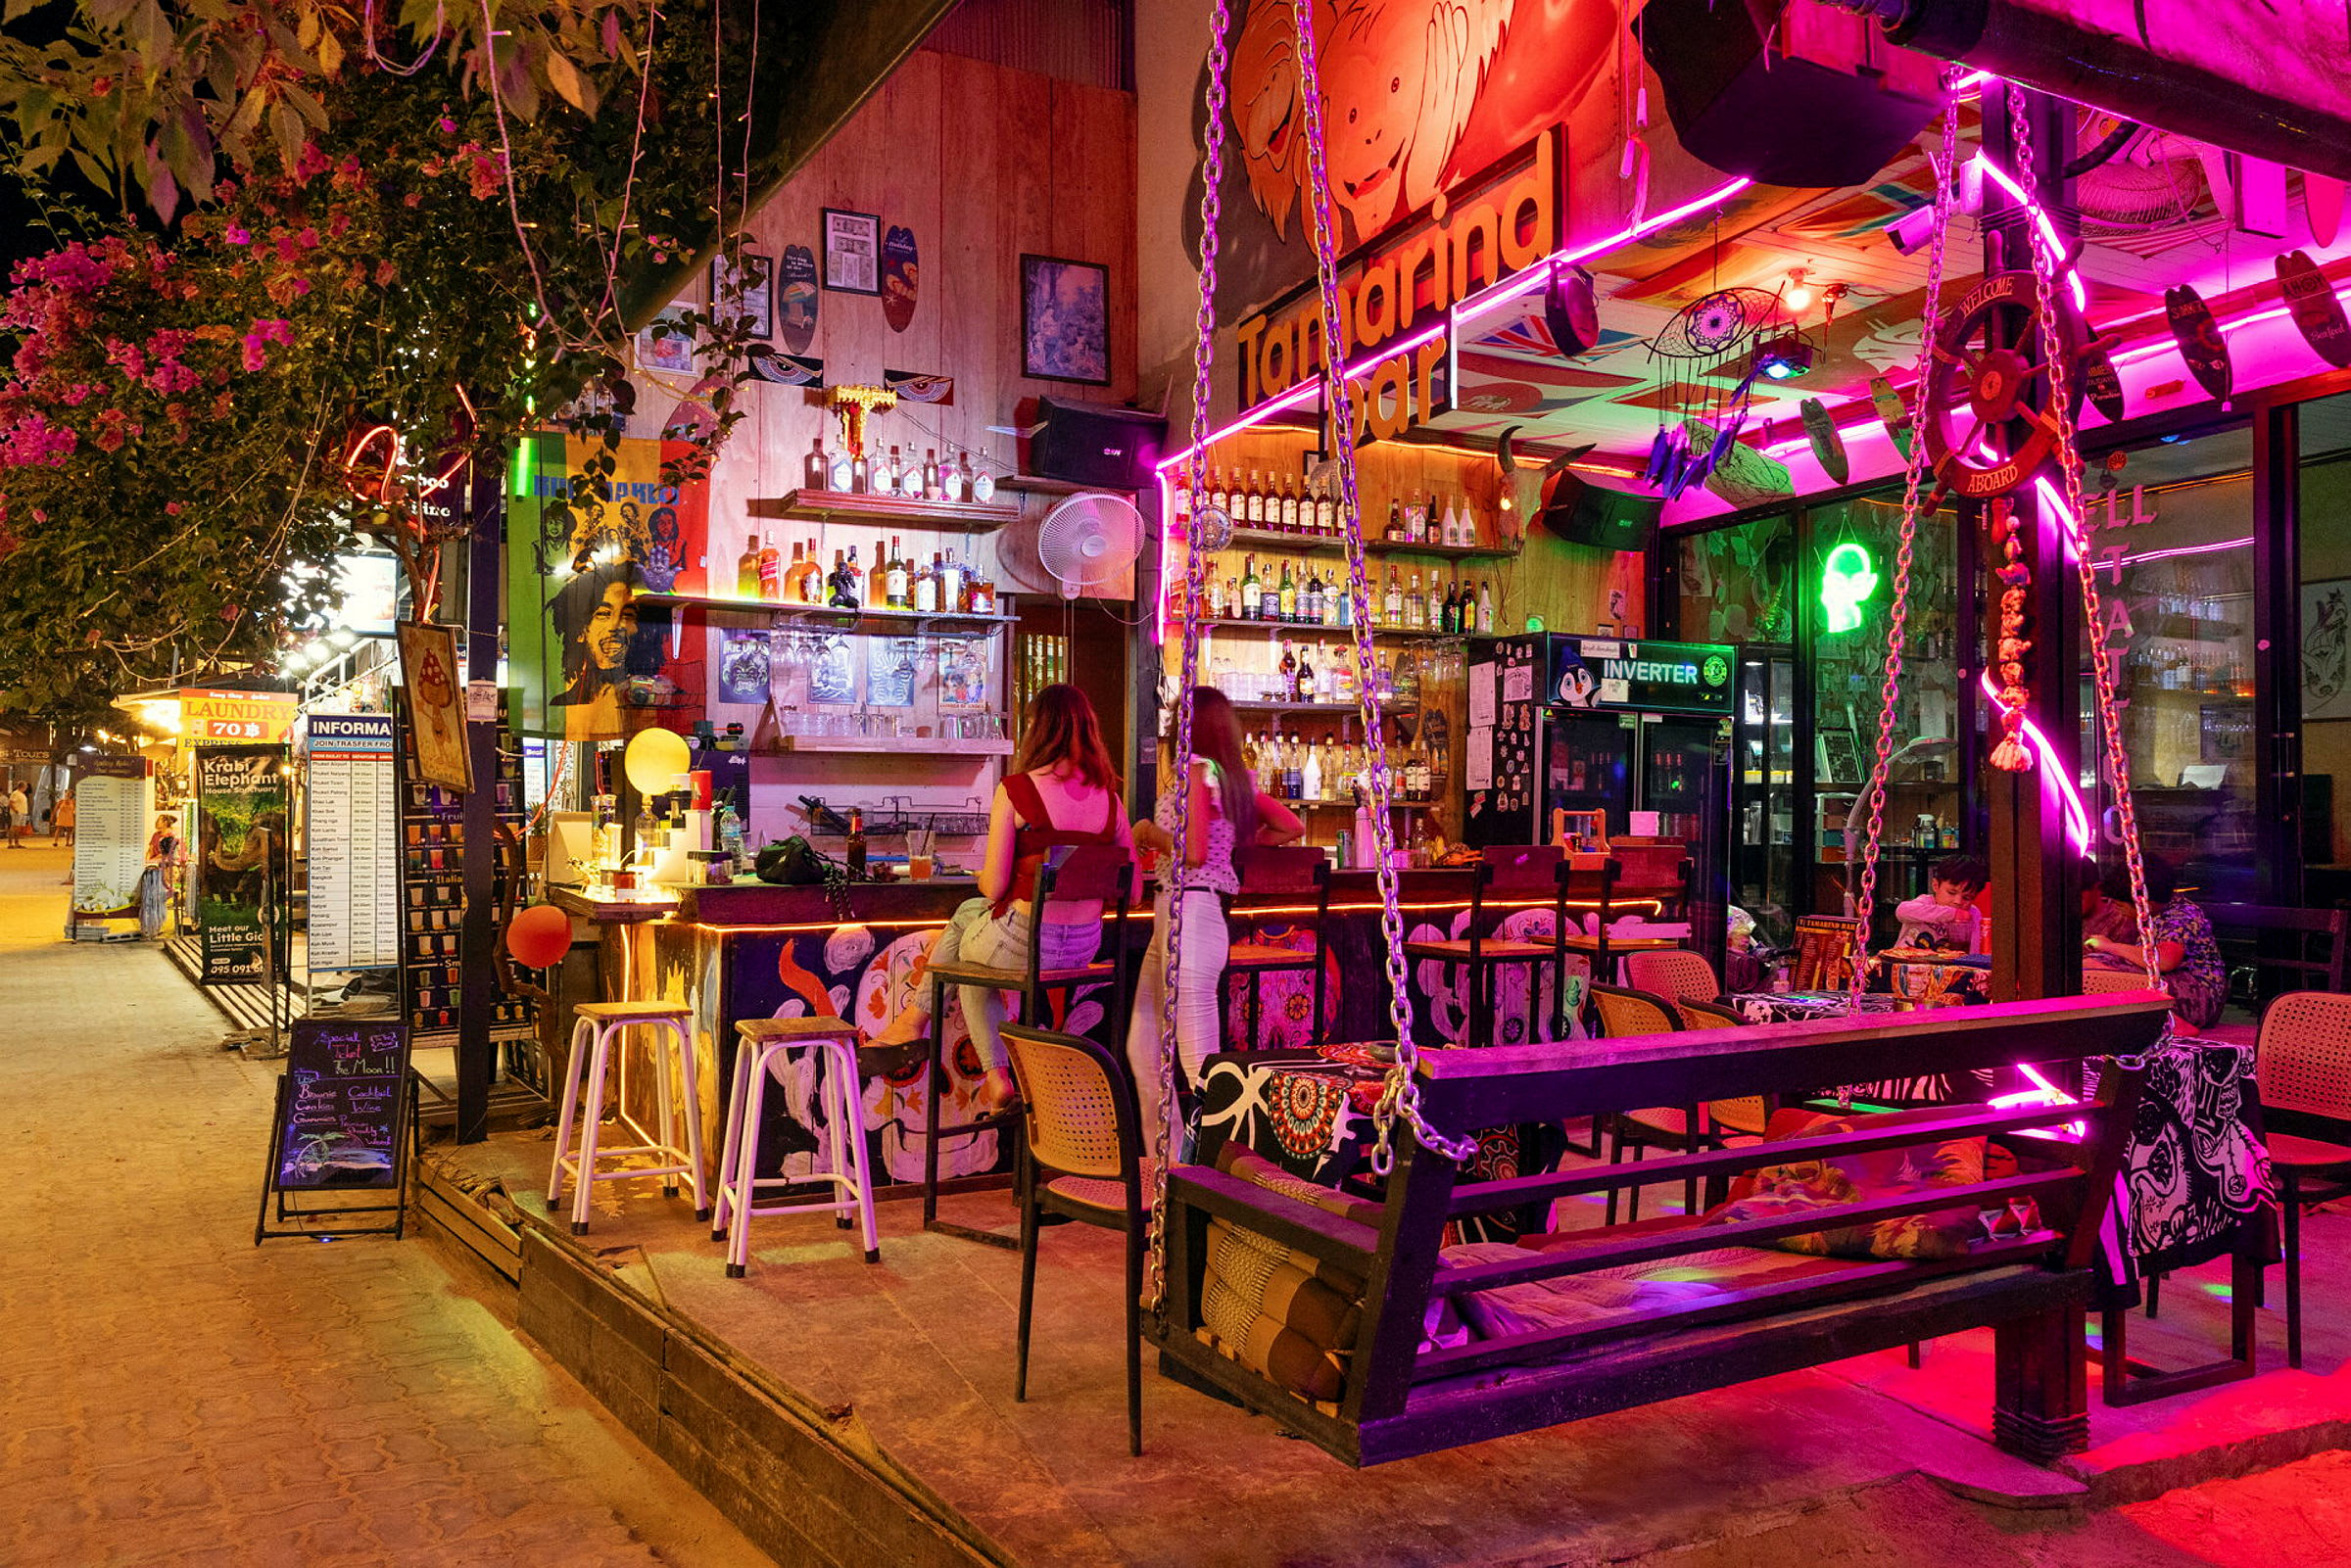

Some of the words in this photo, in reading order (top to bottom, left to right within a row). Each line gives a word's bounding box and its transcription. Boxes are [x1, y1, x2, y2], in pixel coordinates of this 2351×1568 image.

[1240, 129, 1556, 407] Tamarind
[1959, 276, 2015, 318] WELCOME
[1967, 463, 2019, 493] ABOARD
[1604, 659, 1699, 685] INVERTER
[185, 701, 291, 721] LAUNDRY
[213, 722, 241, 736] 70
[313, 721, 392, 736] INFORMA
[13, 748, 50, 759] Tours
[204, 759, 250, 773] Krabi
[205, 773, 279, 788] Elephant
[442, 811, 463, 821] Frui
[210, 932, 243, 943] Little
[211, 965, 230, 974] 095
[232, 965, 251, 974] 091
[353, 1100, 381, 1112] Wine
